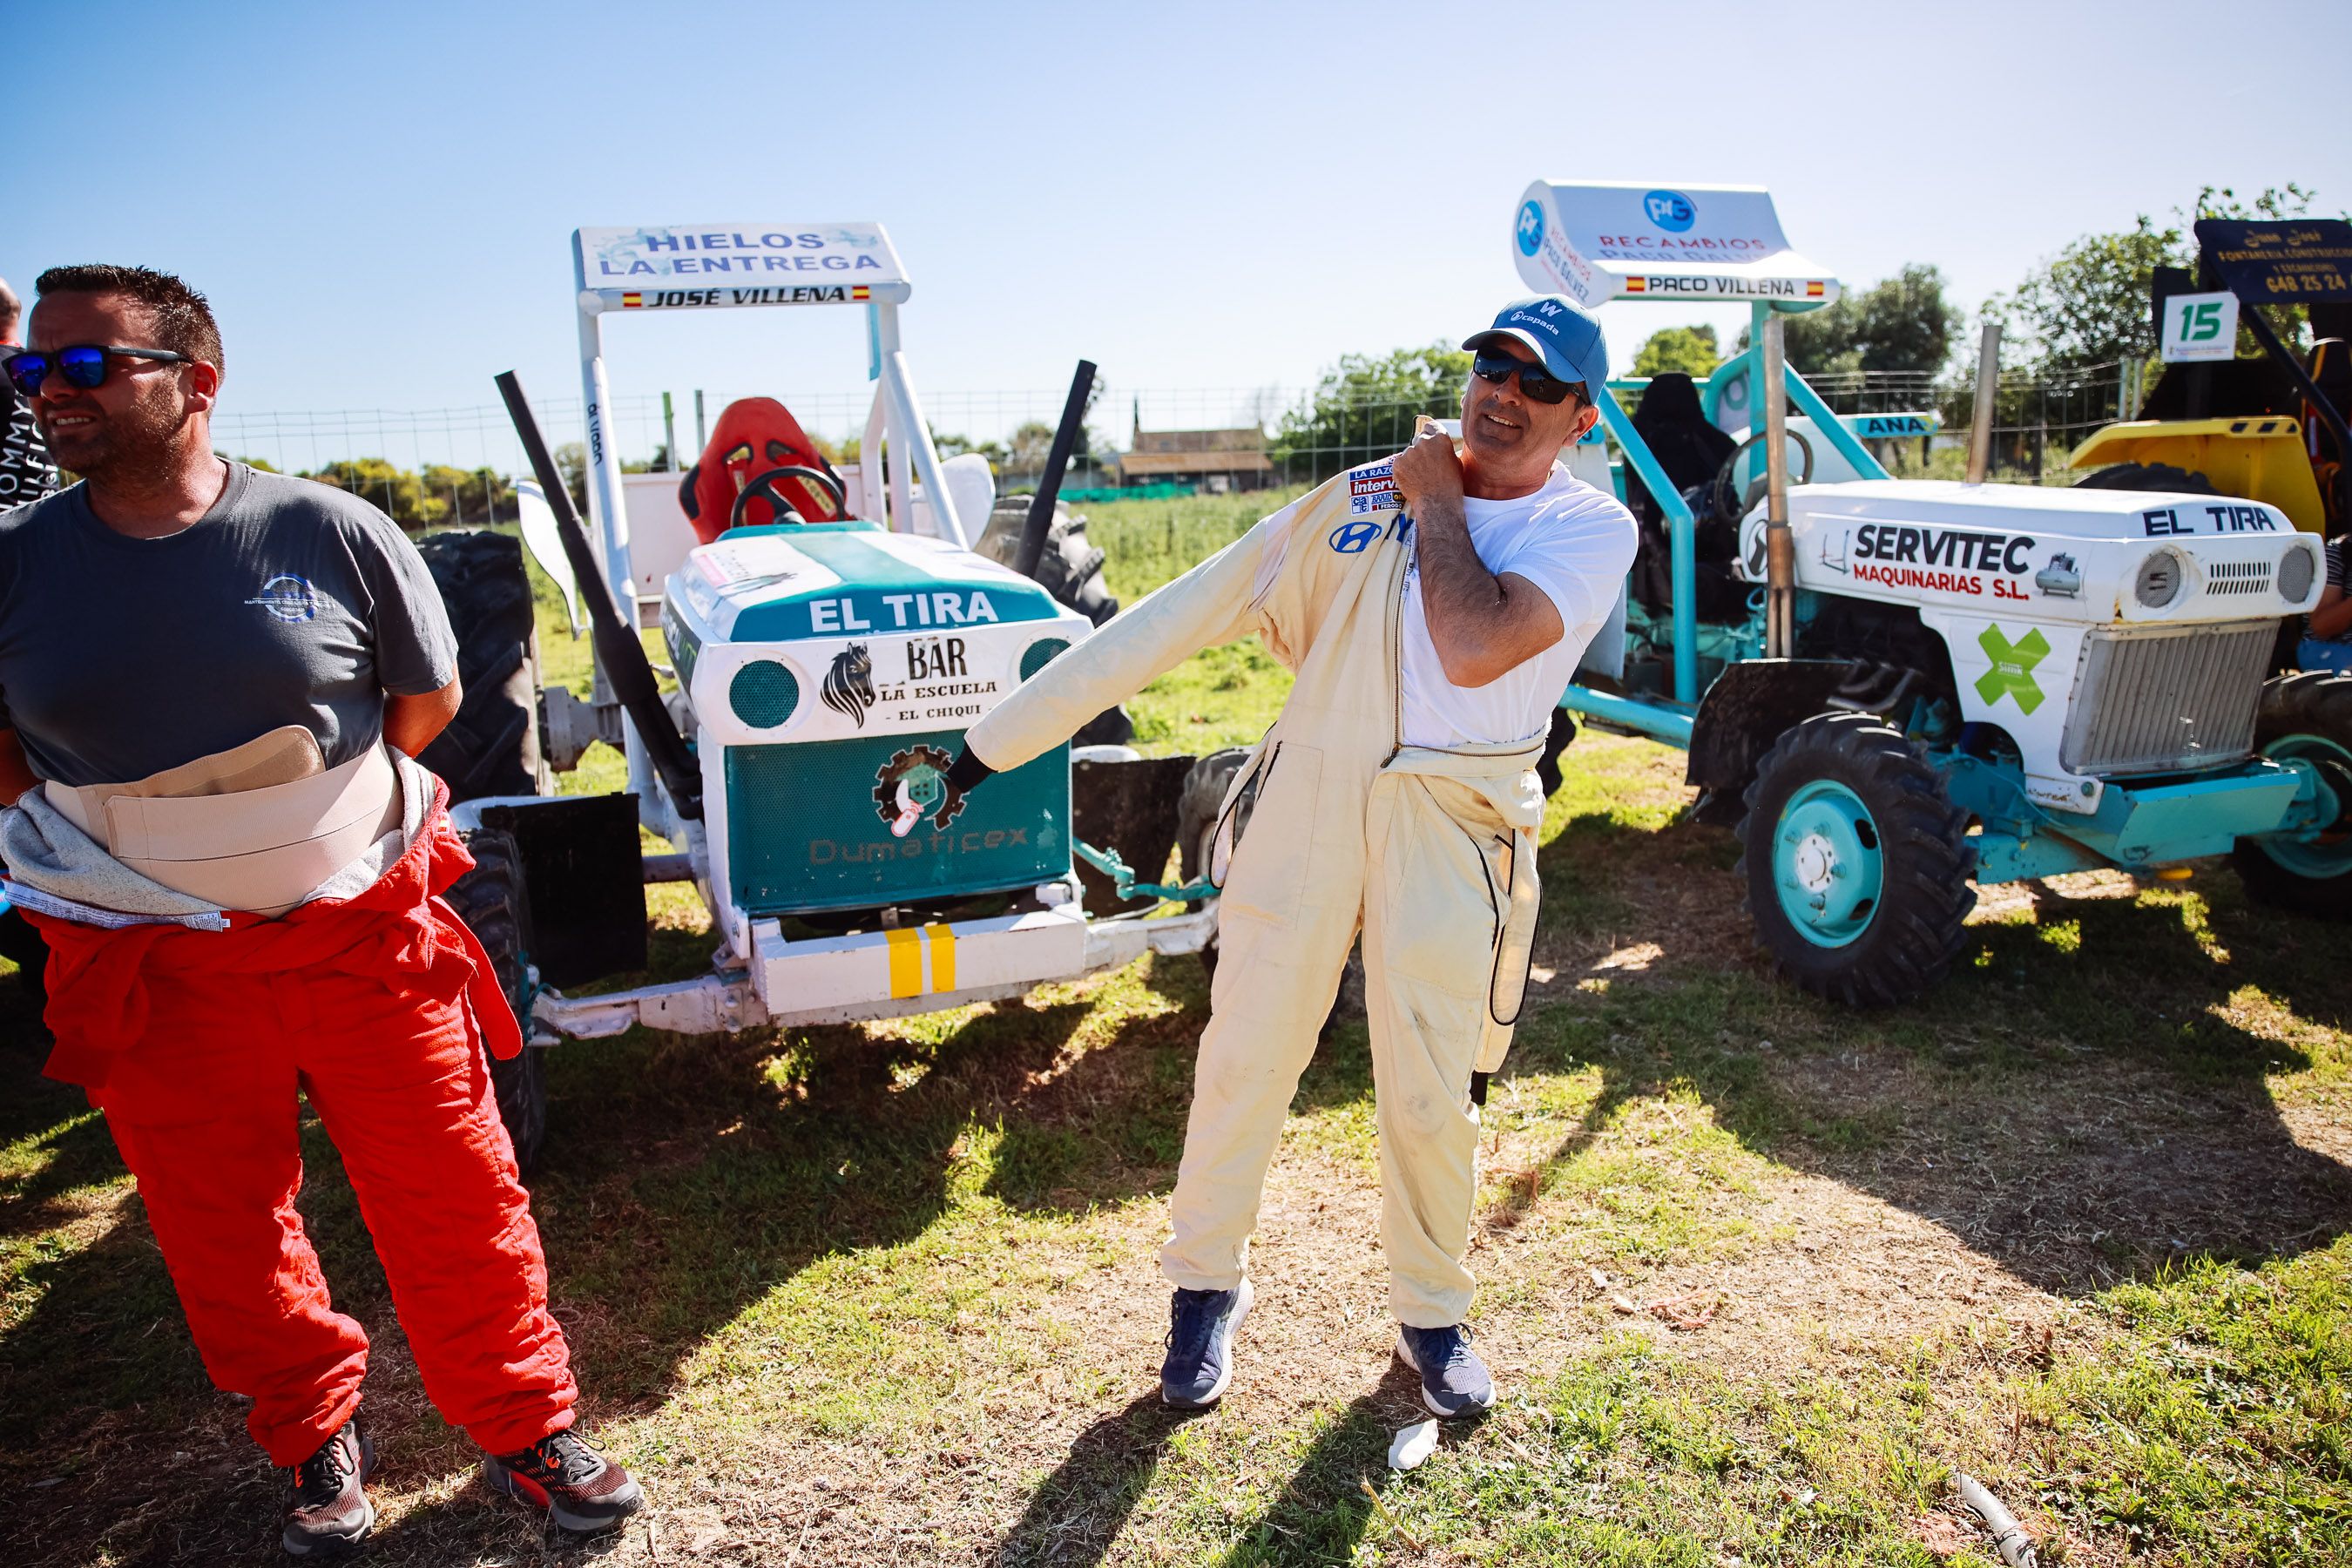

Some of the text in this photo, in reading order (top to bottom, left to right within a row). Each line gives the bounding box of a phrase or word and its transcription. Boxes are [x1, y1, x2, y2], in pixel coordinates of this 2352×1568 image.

[648, 233, 825, 253] HIELOS
[1599, 235, 1766, 250] RECAMBIOS
[599, 254, 882, 276] LA ENTREGA
[647, 286, 846, 308] JOSÉ VILLENA
[1649, 277, 1795, 296] PACO VILLENA
[2180, 301, 2224, 342] 15
[1869, 417, 1926, 433] ANA
[1355, 470, 1368, 479] LA
[2142, 506, 2276, 536] EL TIRA
[1855, 524, 2036, 574] SERVITEC
[1853, 564, 2030, 601] MAQUINARIAS S.L.
[809, 591, 999, 633] EL TIRA
[906, 637, 968, 680] BAR
[880, 681, 997, 702] LA ESCUELA
[898, 704, 982, 721] EL CHIQUI
